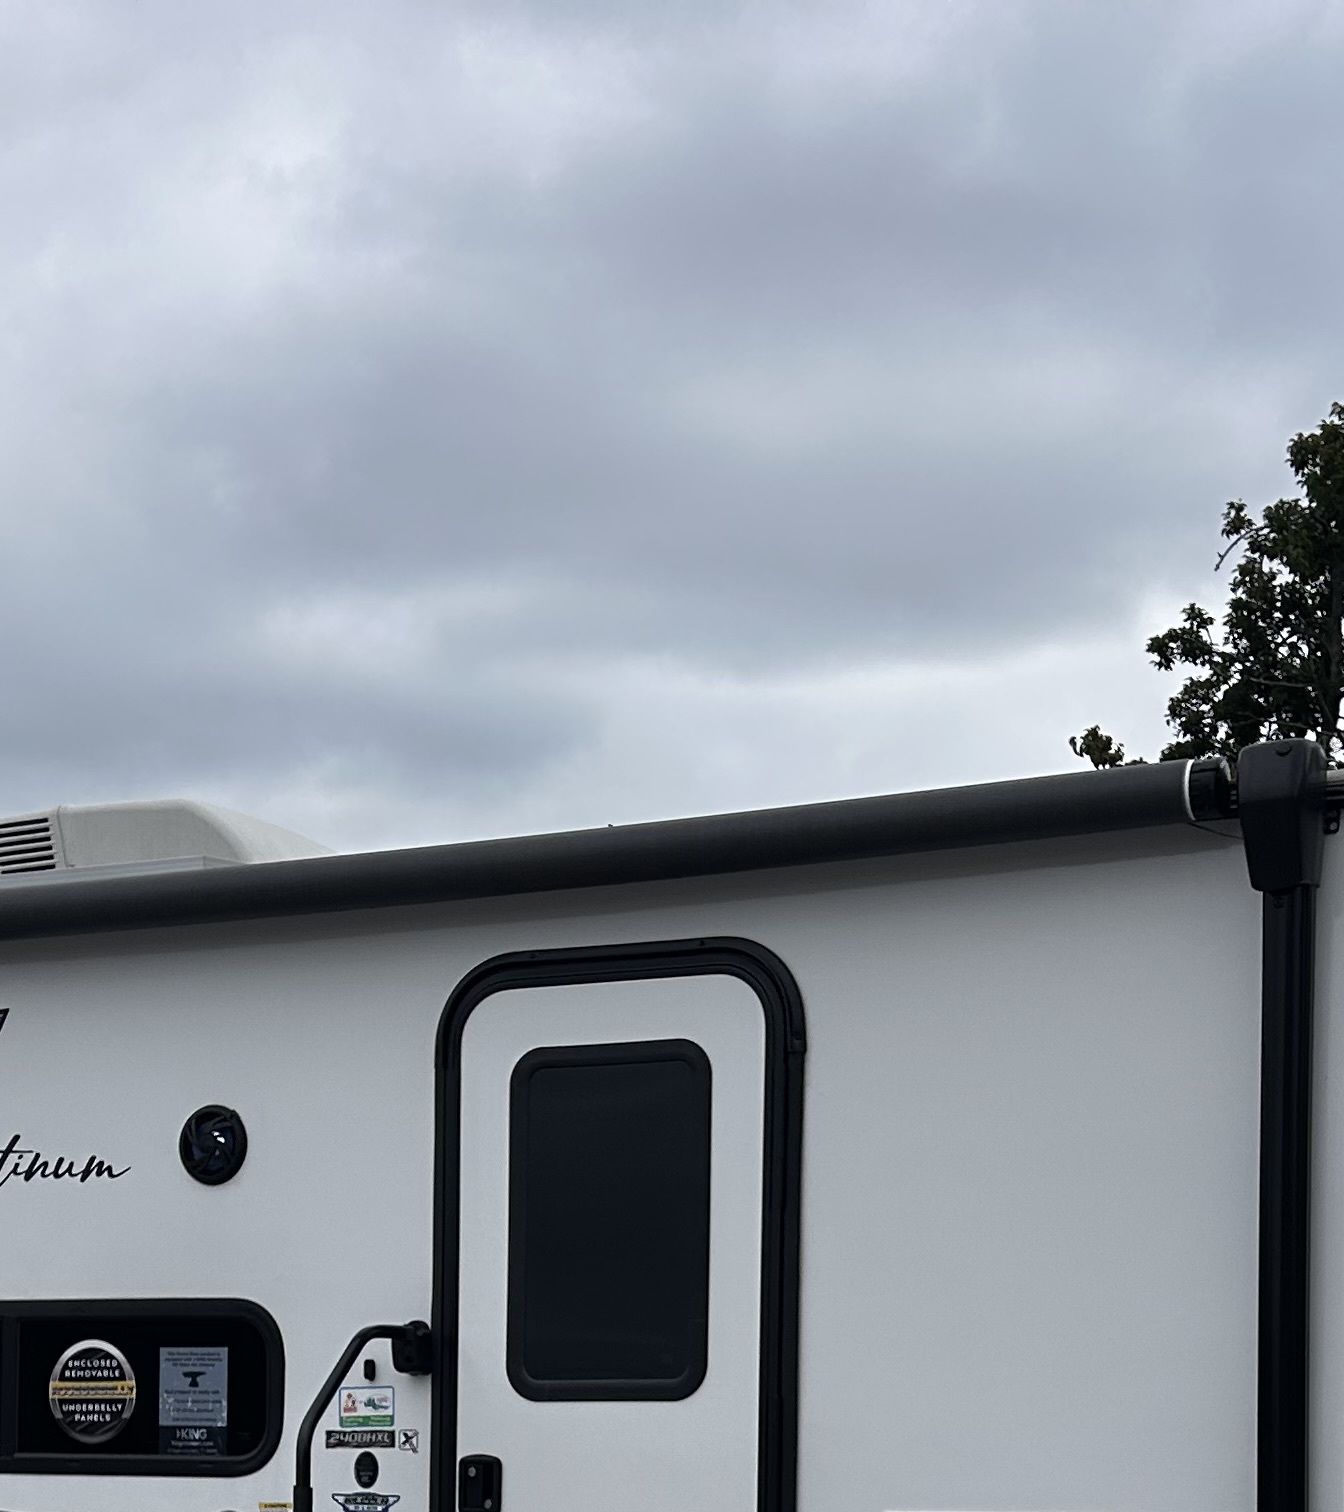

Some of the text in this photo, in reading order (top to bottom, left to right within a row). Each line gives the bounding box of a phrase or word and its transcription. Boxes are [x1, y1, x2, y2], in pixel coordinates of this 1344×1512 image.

[68, 1359, 118, 1368] ENCLOSED
[64, 1369, 121, 1378] REMOVABLE
[62, 1403, 123, 1412] UNDERBELLY
[74, 1413, 111, 1422] PANELS
